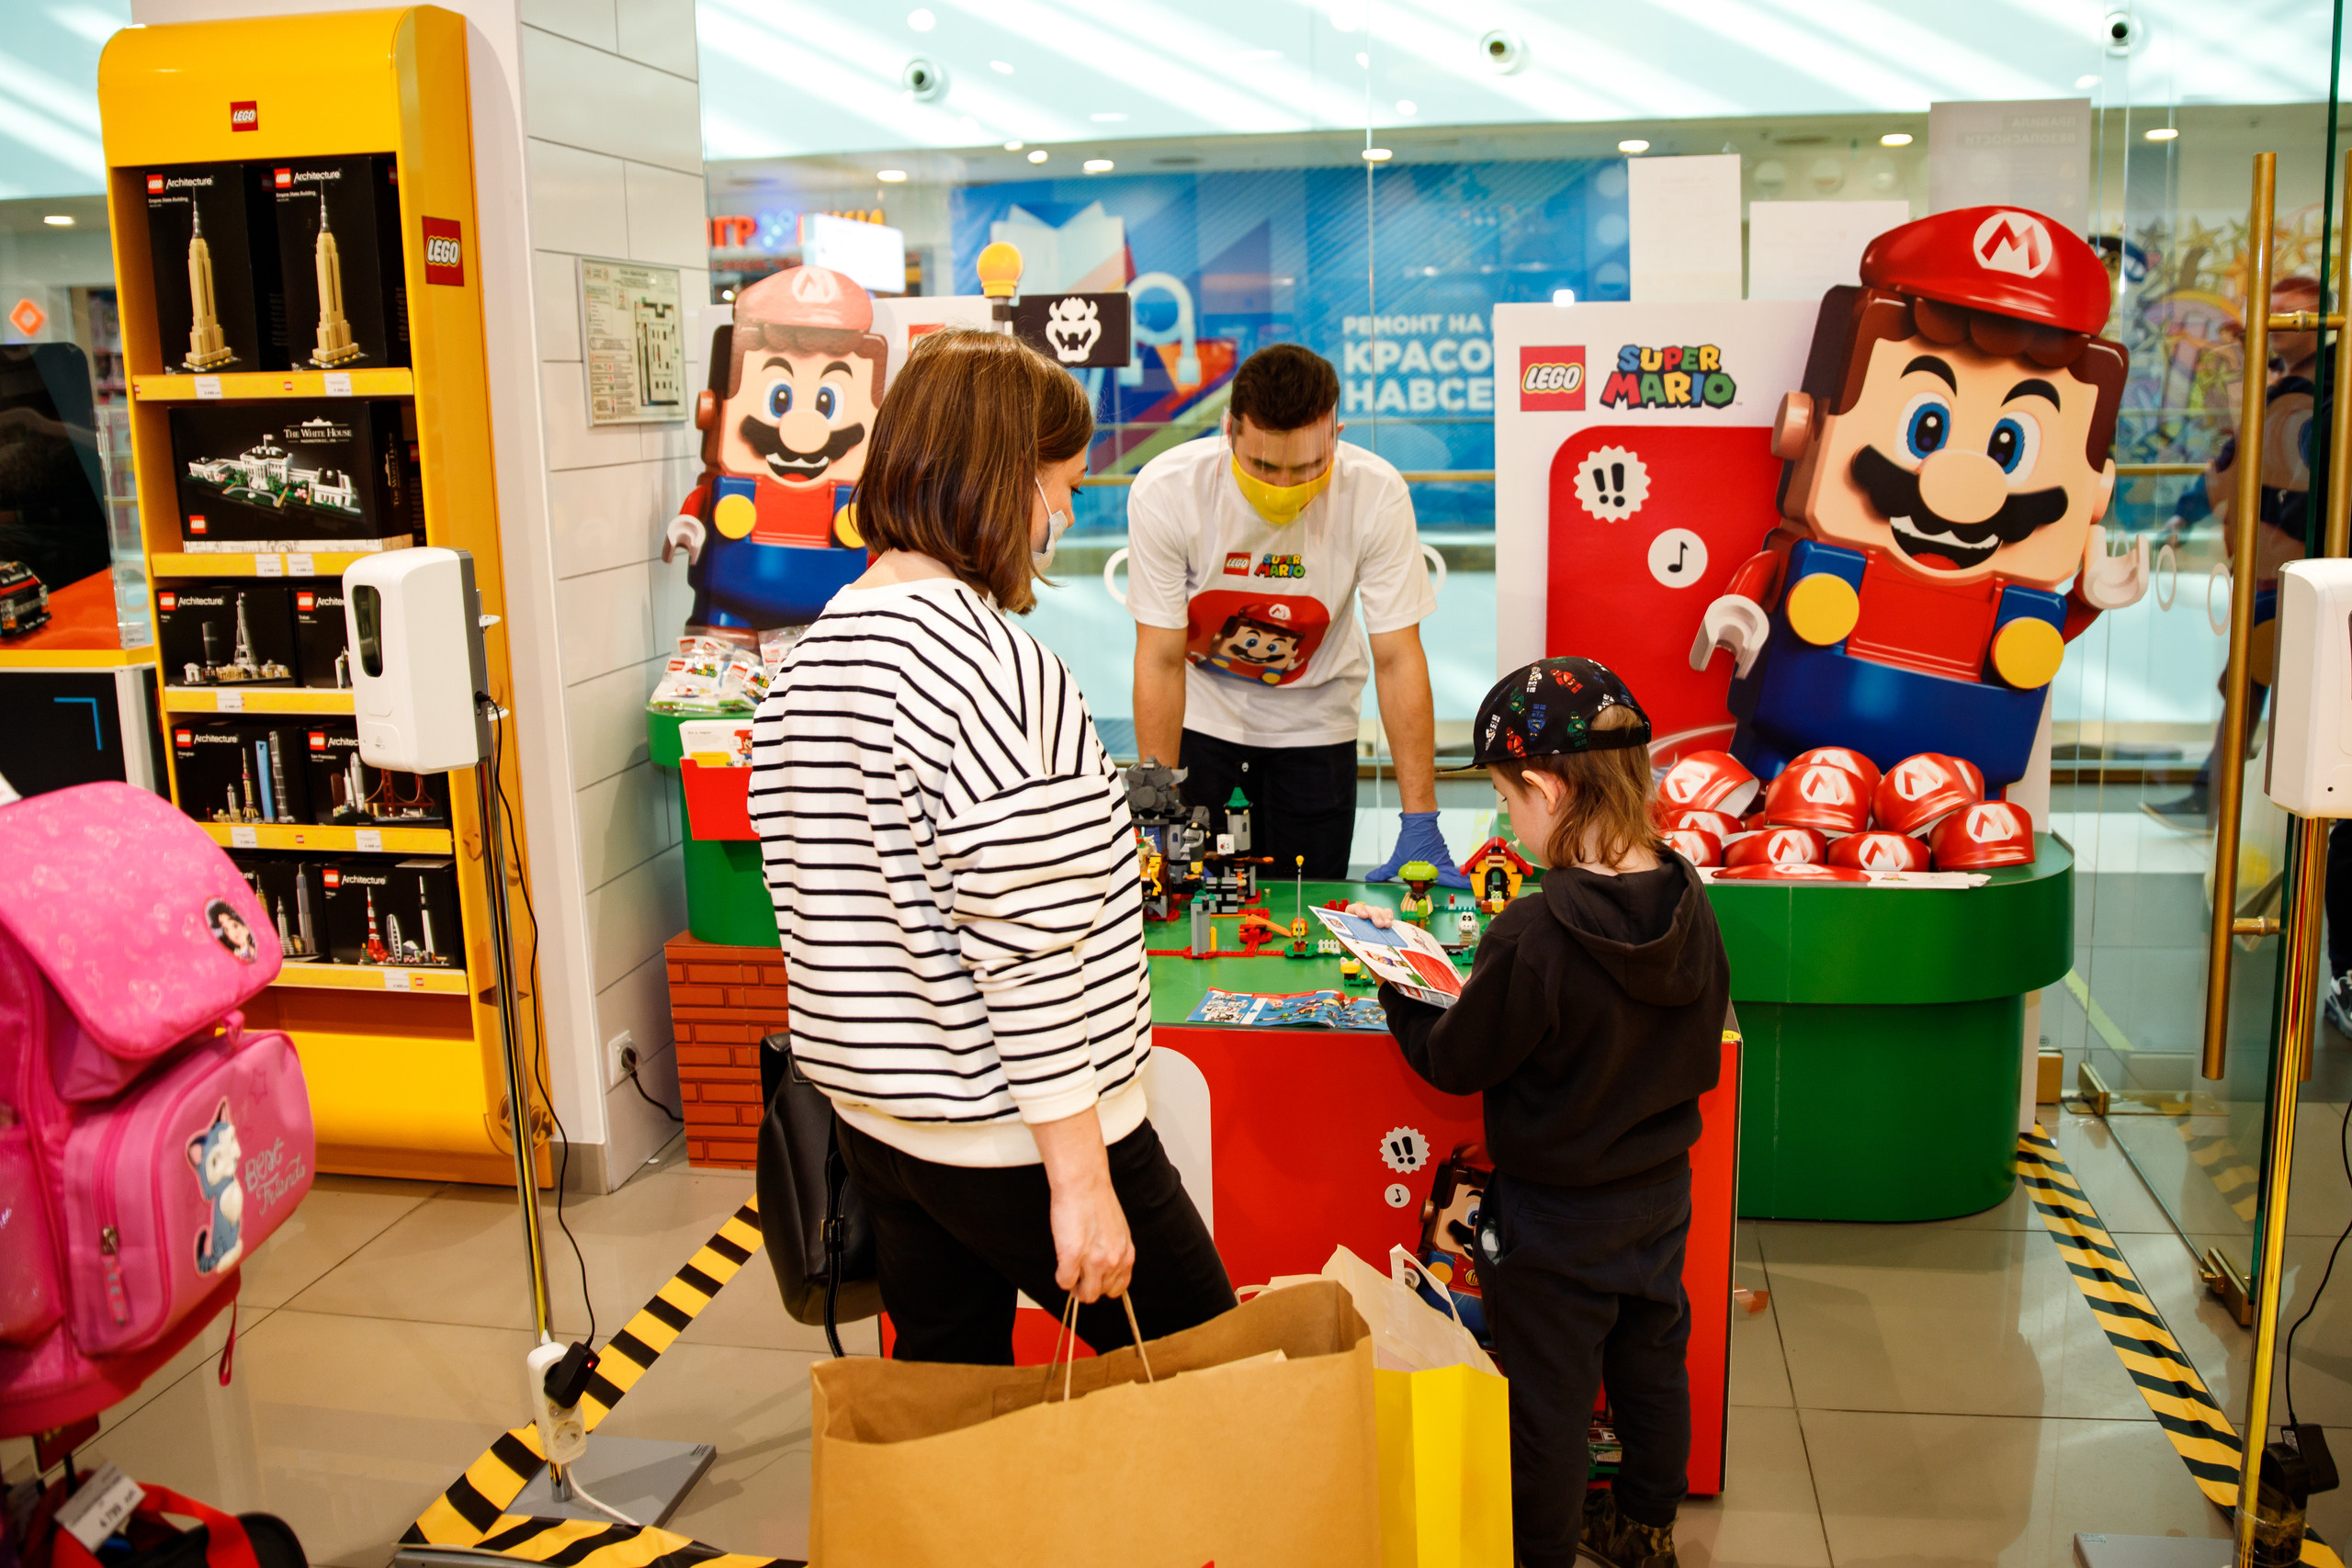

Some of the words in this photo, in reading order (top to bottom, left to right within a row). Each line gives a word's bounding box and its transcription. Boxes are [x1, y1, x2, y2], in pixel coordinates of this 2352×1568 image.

[232, 109, 255, 123] LEGO
[166, 175, 212, 190] Architecture
[294, 169, 341, 185] Architecture
[426, 237, 459, 265] LEGO
[1342, 314, 1443, 336] РЕМОНТ
[1448, 313, 1485, 333] НА
[1343, 338, 1494, 375] КРАСО
[1617, 344, 1722, 372] SUPER
[1522, 364, 1583, 393] LEGO
[1344, 377, 1495, 412] НАВСЕ
[1600, 370, 1736, 410] MARIO
[300, 428, 326, 438] WHITE
[327, 427, 352, 437] HOUSE
[1226, 558, 1249, 569] LEGO
[1262, 554, 1302, 565] SUPER
[1254, 564, 1306, 579] MARIO
[178, 595, 223, 608] Architecture
[194, 733, 238, 746] Architecture
[328, 737, 359, 749] Architec
[342, 874, 386, 886] Architecture
[244, 1136, 285, 1193] Best
